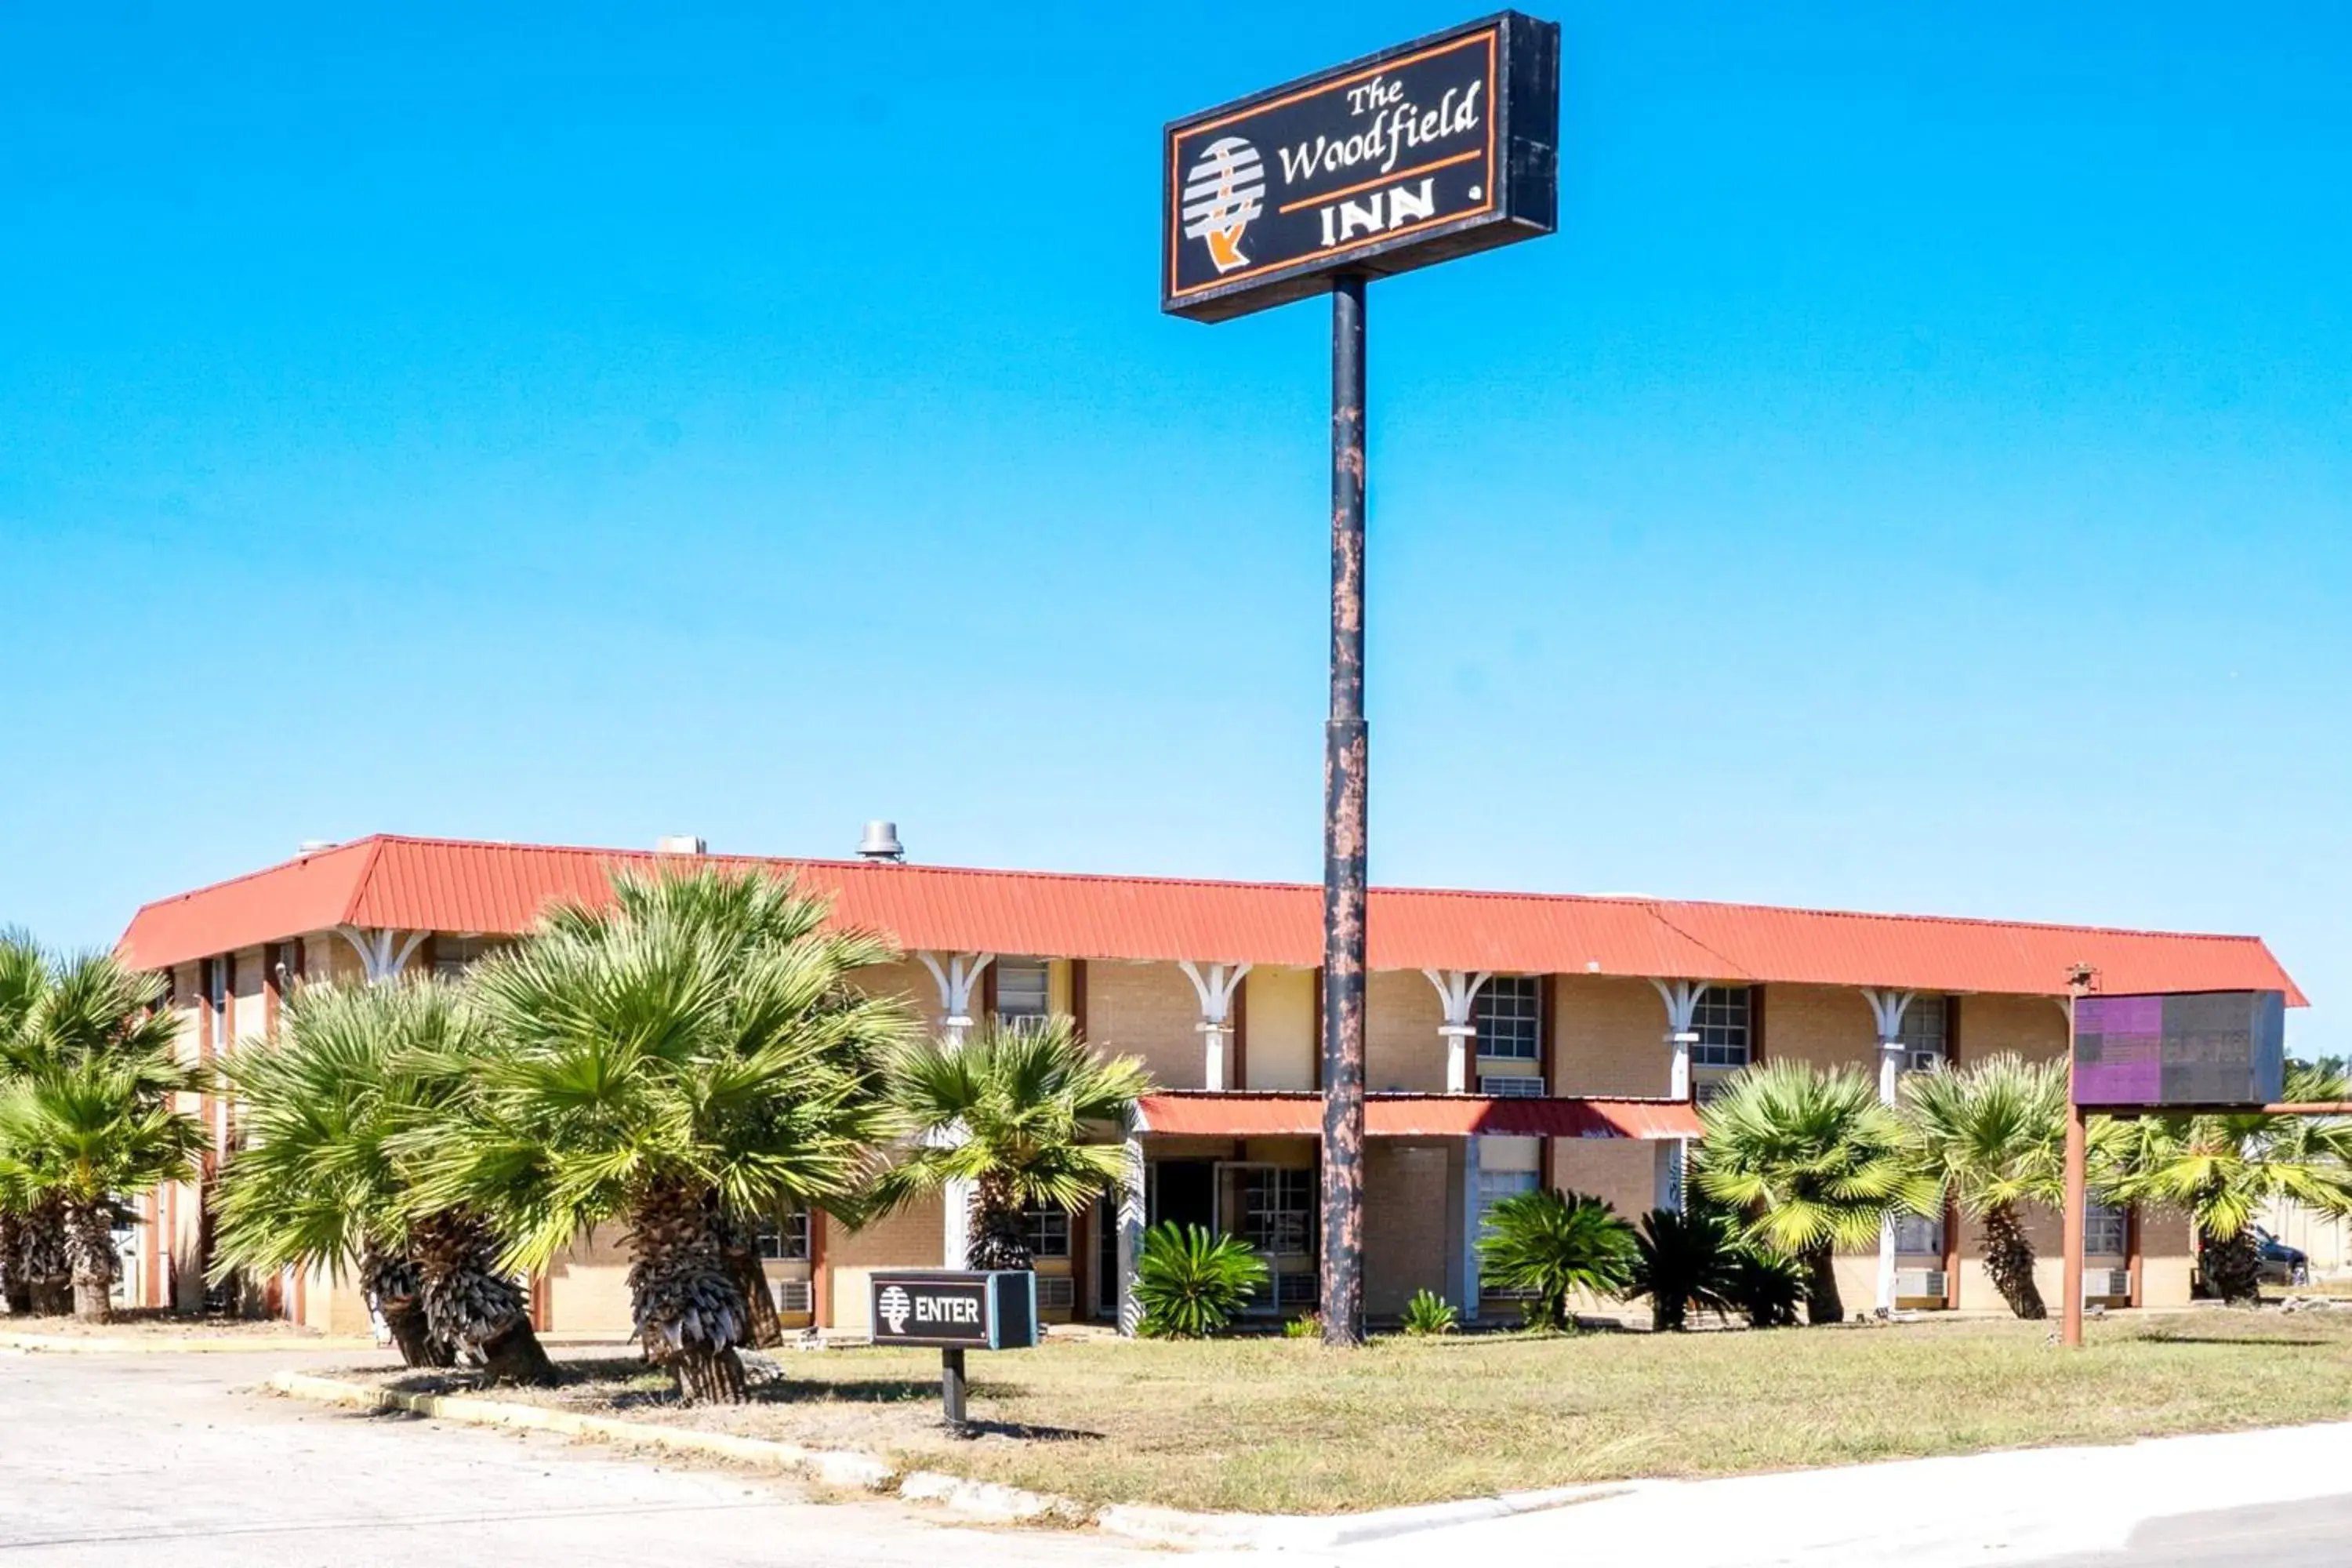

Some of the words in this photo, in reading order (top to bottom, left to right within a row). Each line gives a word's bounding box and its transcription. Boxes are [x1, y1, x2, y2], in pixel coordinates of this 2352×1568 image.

[1346, 75, 1403, 116] The
[1278, 80, 1481, 184] Woodfield
[1320, 177, 1436, 247] INN
[915, 1296, 979, 1323] ENTER
